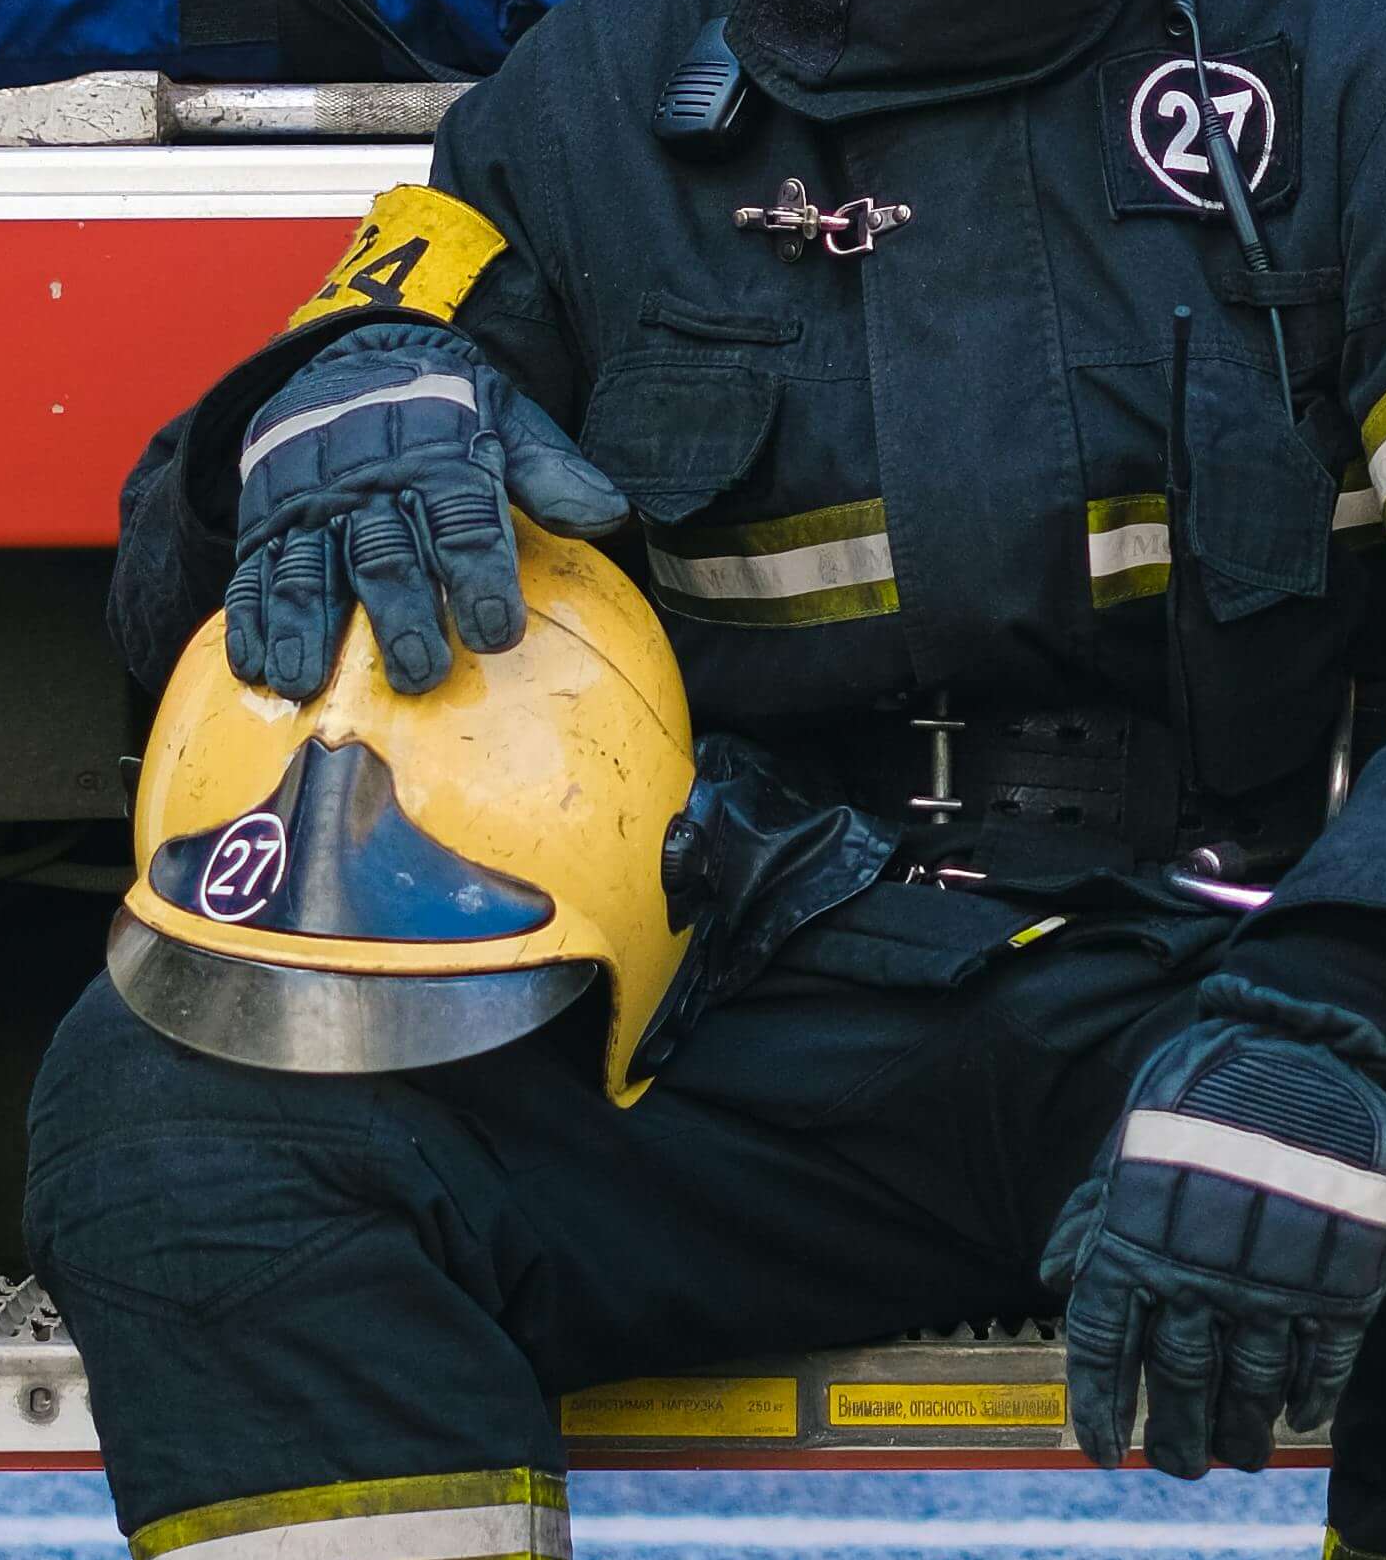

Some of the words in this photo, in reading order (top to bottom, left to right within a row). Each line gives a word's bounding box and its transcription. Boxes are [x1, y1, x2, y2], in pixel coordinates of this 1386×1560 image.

[1157, 89, 1253, 174] 27
[207, 835, 281, 897] 27
[910, 1398, 977, 1418] опасность
